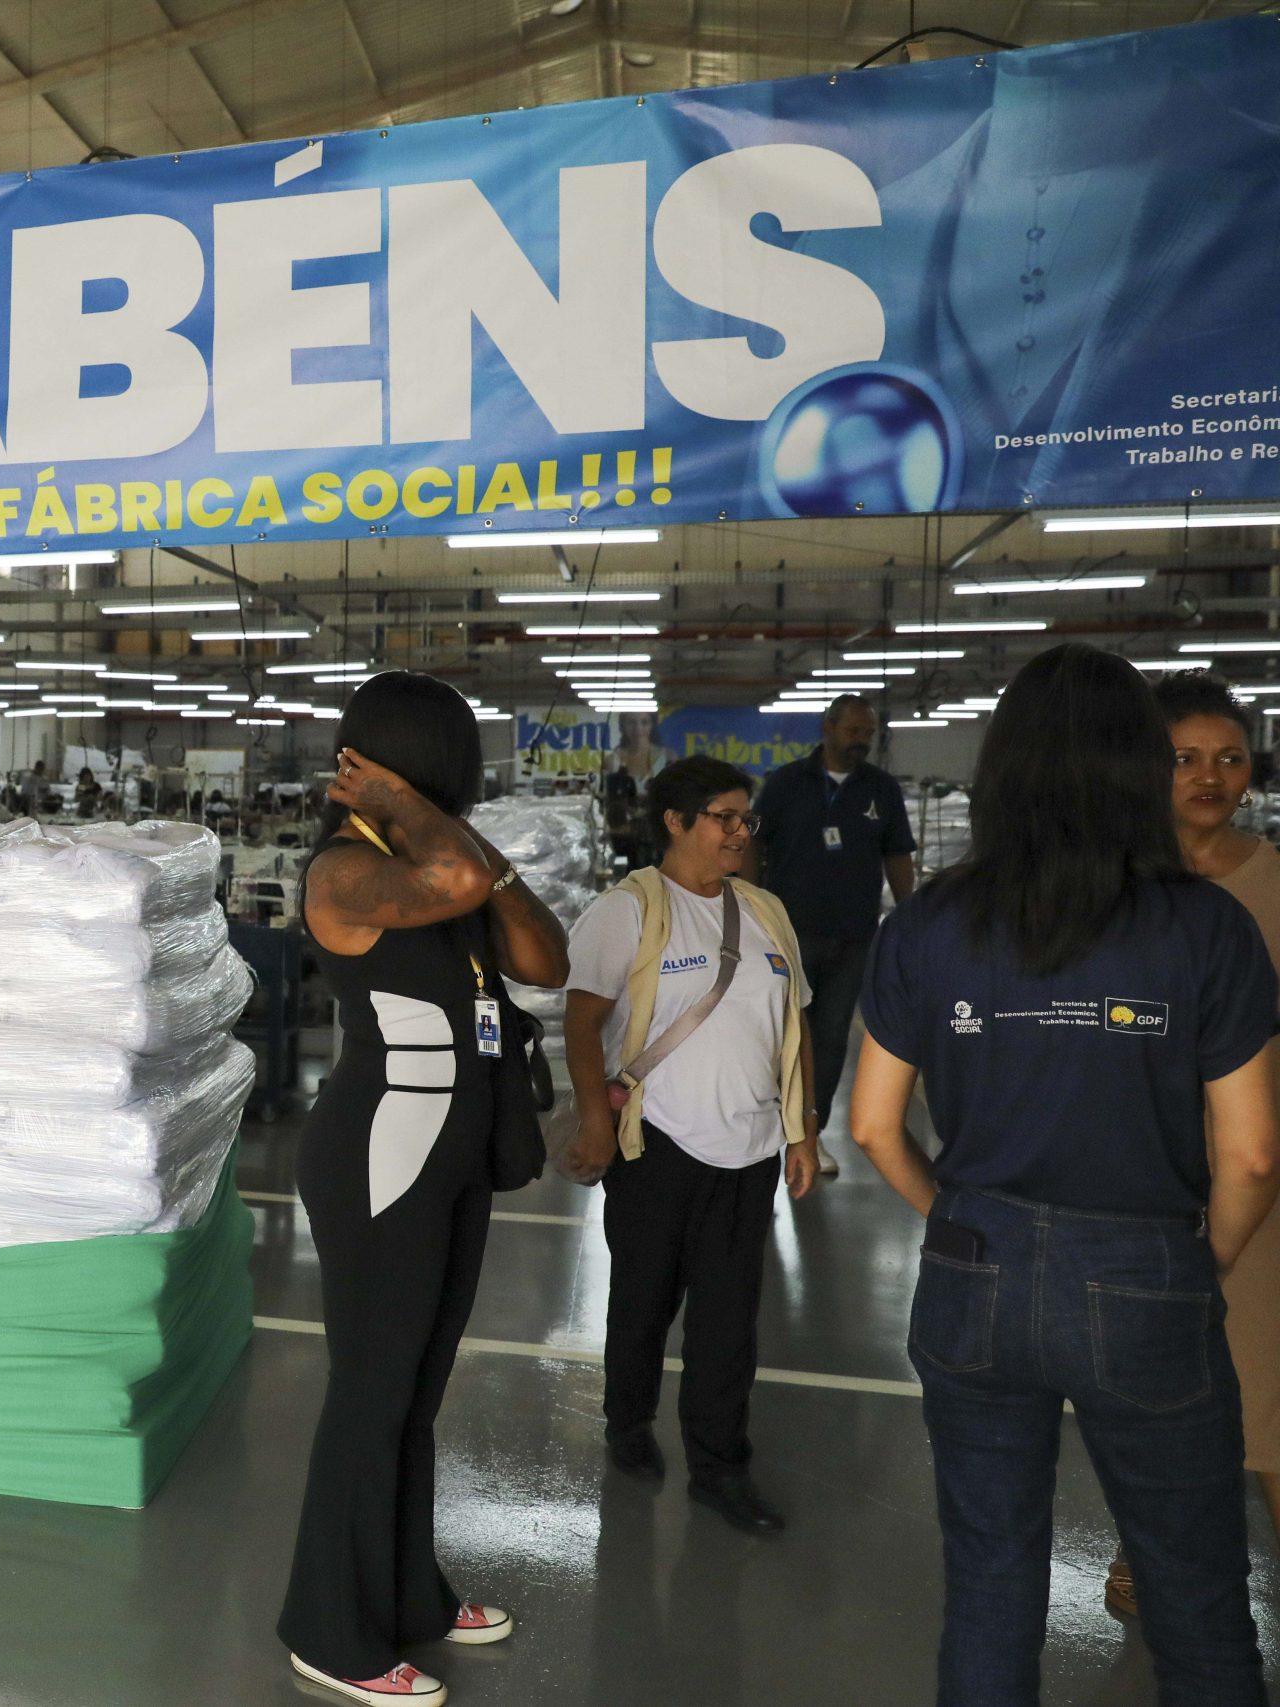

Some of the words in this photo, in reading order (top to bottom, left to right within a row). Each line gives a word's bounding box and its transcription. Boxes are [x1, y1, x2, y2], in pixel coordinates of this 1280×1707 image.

[1170, 386, 1280, 409] Secretari
[994, 422, 1184, 449] Desenvolvimento
[1126, 444, 1223, 465] Trabalho
[1230, 447, 1244, 460] e
[1251, 443, 1279, 460] Re
[301, 447, 673, 523] SOCIAL!!!
[662, 955, 707, 970] ALUNO
[1051, 1000, 1087, 1008] Secretaria
[1088, 1000, 1099, 1008] de
[994, 1010, 1056, 1018] Desenvolvimento
[950, 1016, 983, 1028] FÁBRICA
[1075, 1018, 1100, 1026] Renda
[1136, 1015, 1164, 1026] GDF
[954, 1026, 982, 1034] SOCIAL
